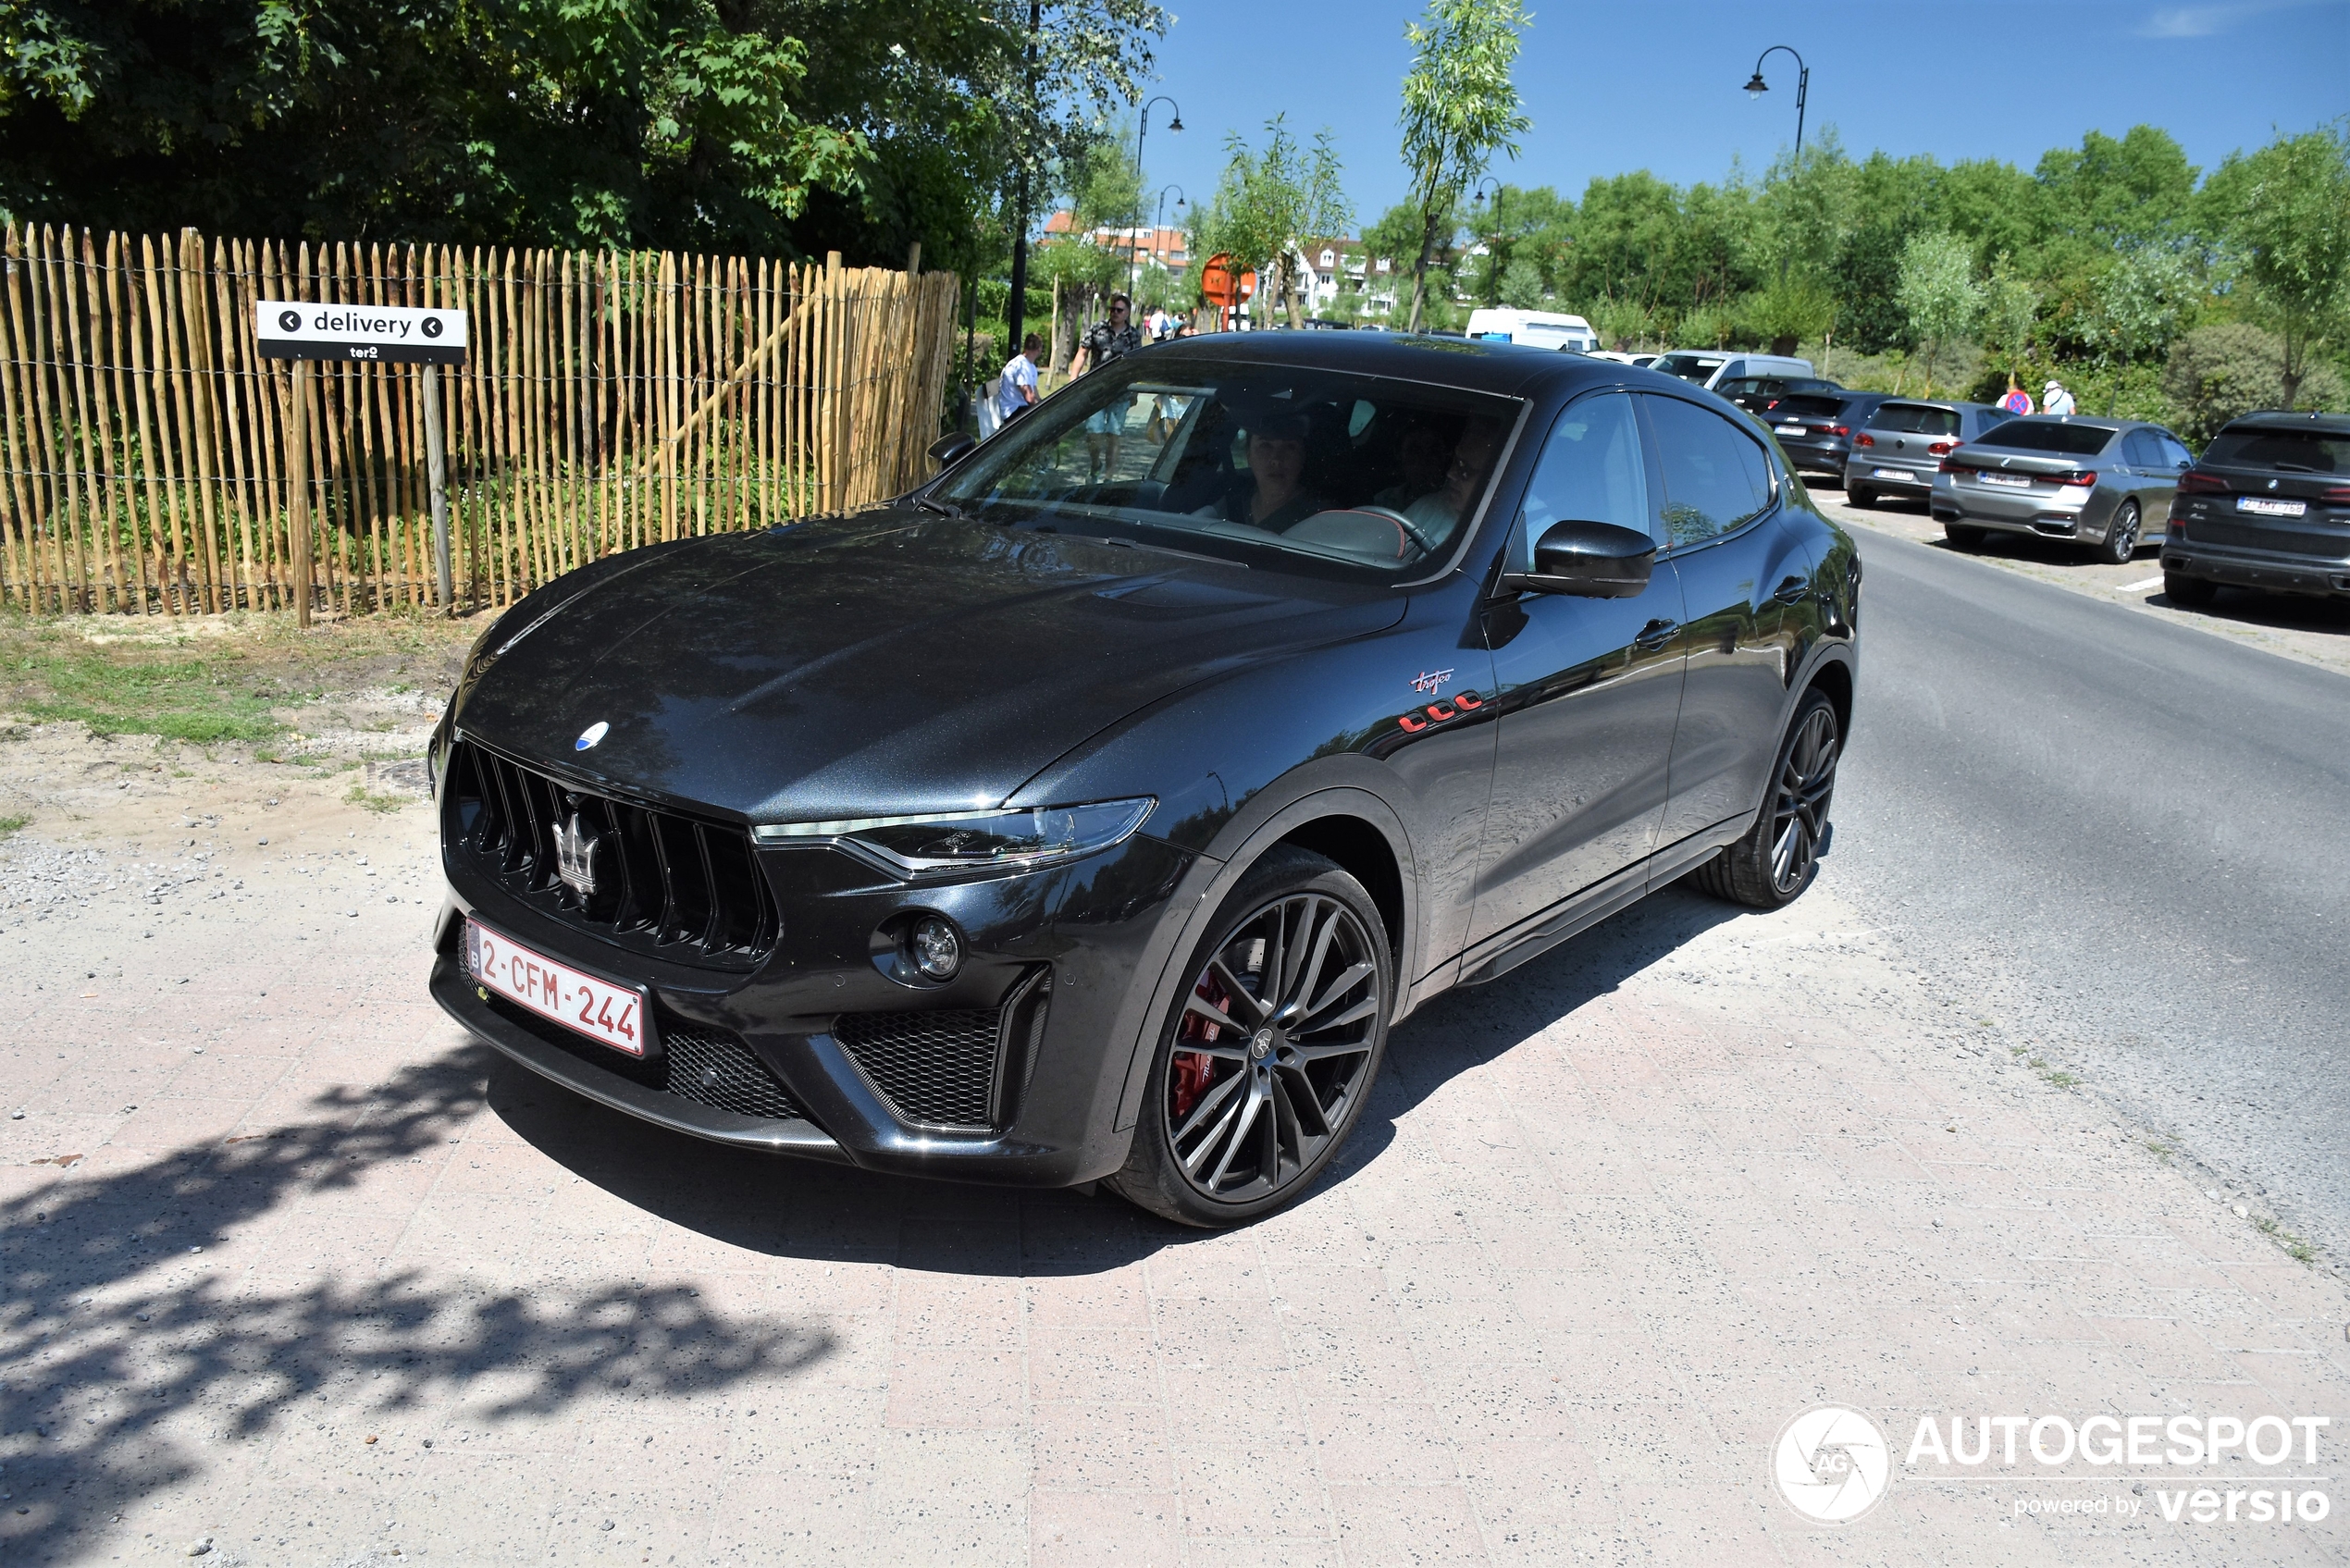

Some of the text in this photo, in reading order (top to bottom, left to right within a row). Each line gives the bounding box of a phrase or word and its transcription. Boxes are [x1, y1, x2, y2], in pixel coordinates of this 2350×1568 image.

[315, 311, 412, 339] delivery
[471, 951, 479, 969] B
[483, 939, 635, 1042] 2-CFM-244
